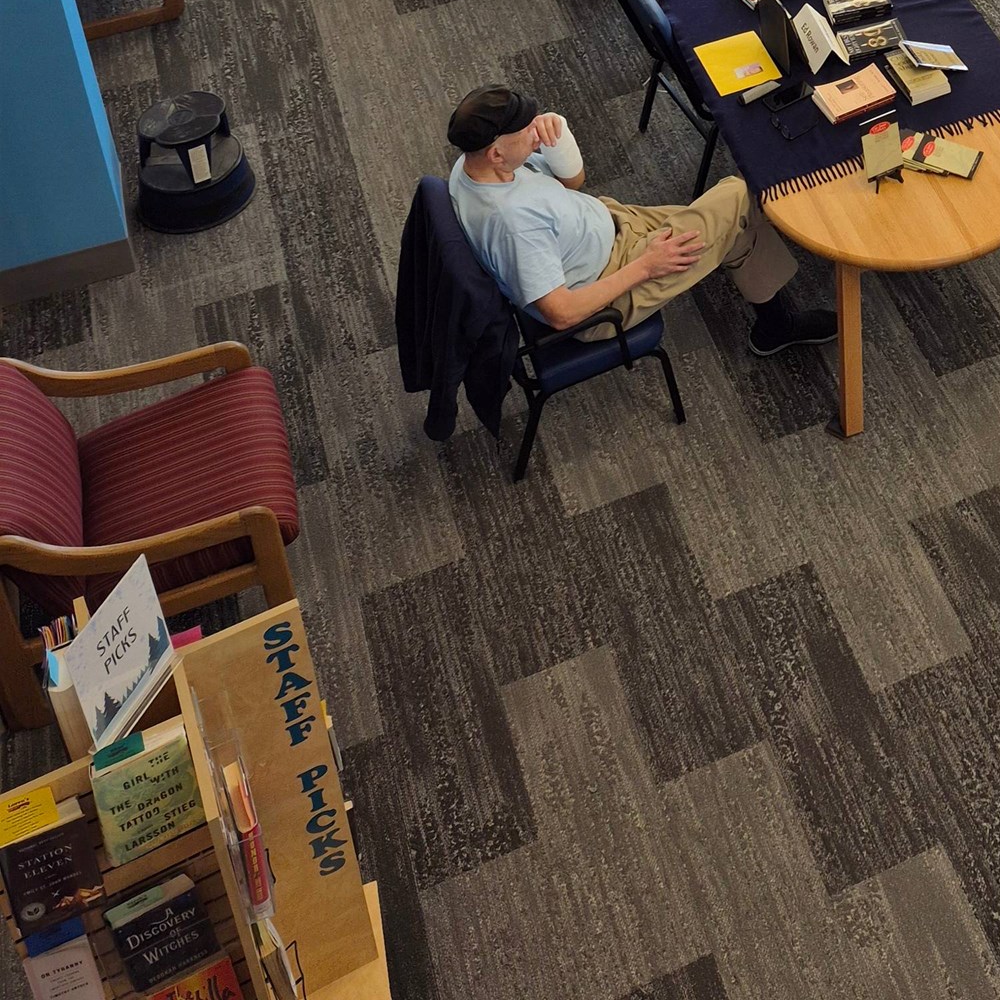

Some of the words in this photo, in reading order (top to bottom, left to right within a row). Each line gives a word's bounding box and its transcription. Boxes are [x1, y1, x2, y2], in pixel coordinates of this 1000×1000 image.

[801, 23, 809, 34] Ed
[806, 30, 819, 53] Rowan
[96, 606, 130, 657] STAFF
[104, 627, 137, 675] PICKS
[148, 752, 170, 767] THE
[264, 621, 316, 746] STAFF
[297, 764, 348, 877] PICKS
[123, 772, 150, 790] GIRL
[150, 766, 180, 785] WITH
[110, 800, 132, 815] THE
[138, 783, 183, 812] DRAGON
[120, 807, 160, 832] TATTOO
[164, 800, 196, 821] STIEG
[125, 821, 176, 852] LARSSON
[18, 843, 72, 870] STATION
[24, 855, 73, 880] ELEVEN
[126, 908, 197, 950] DISCOVERY
[143, 930, 200, 965] WITCHES
[52, 960, 82, 974] TYRANNY
[149, 966, 177, 984] DEBORAH
[179, 949, 208, 967] HARKNESS
